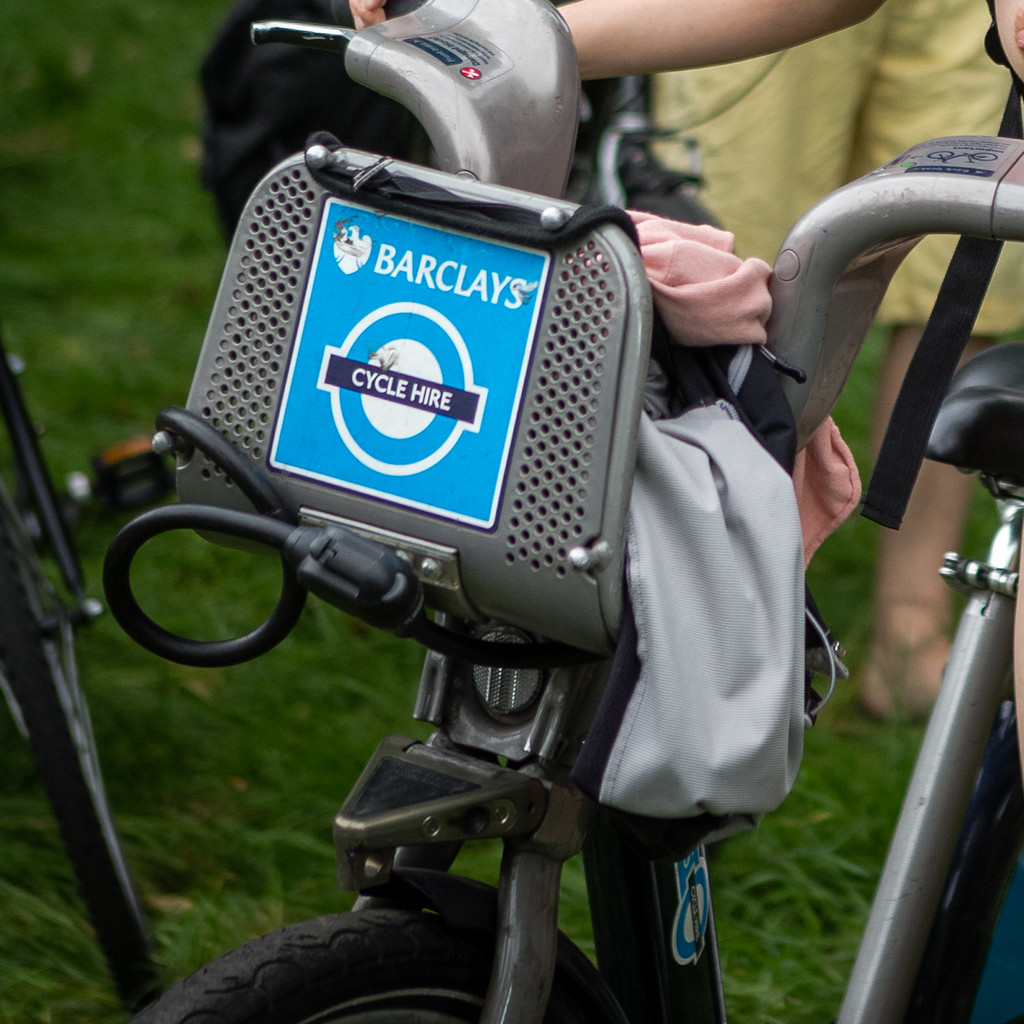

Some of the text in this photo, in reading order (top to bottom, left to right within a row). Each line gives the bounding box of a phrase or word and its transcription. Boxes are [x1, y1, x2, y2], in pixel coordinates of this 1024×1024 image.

[373, 243, 531, 310] BARCLAYS
[351, 367, 454, 412] CYCLE HIRE
